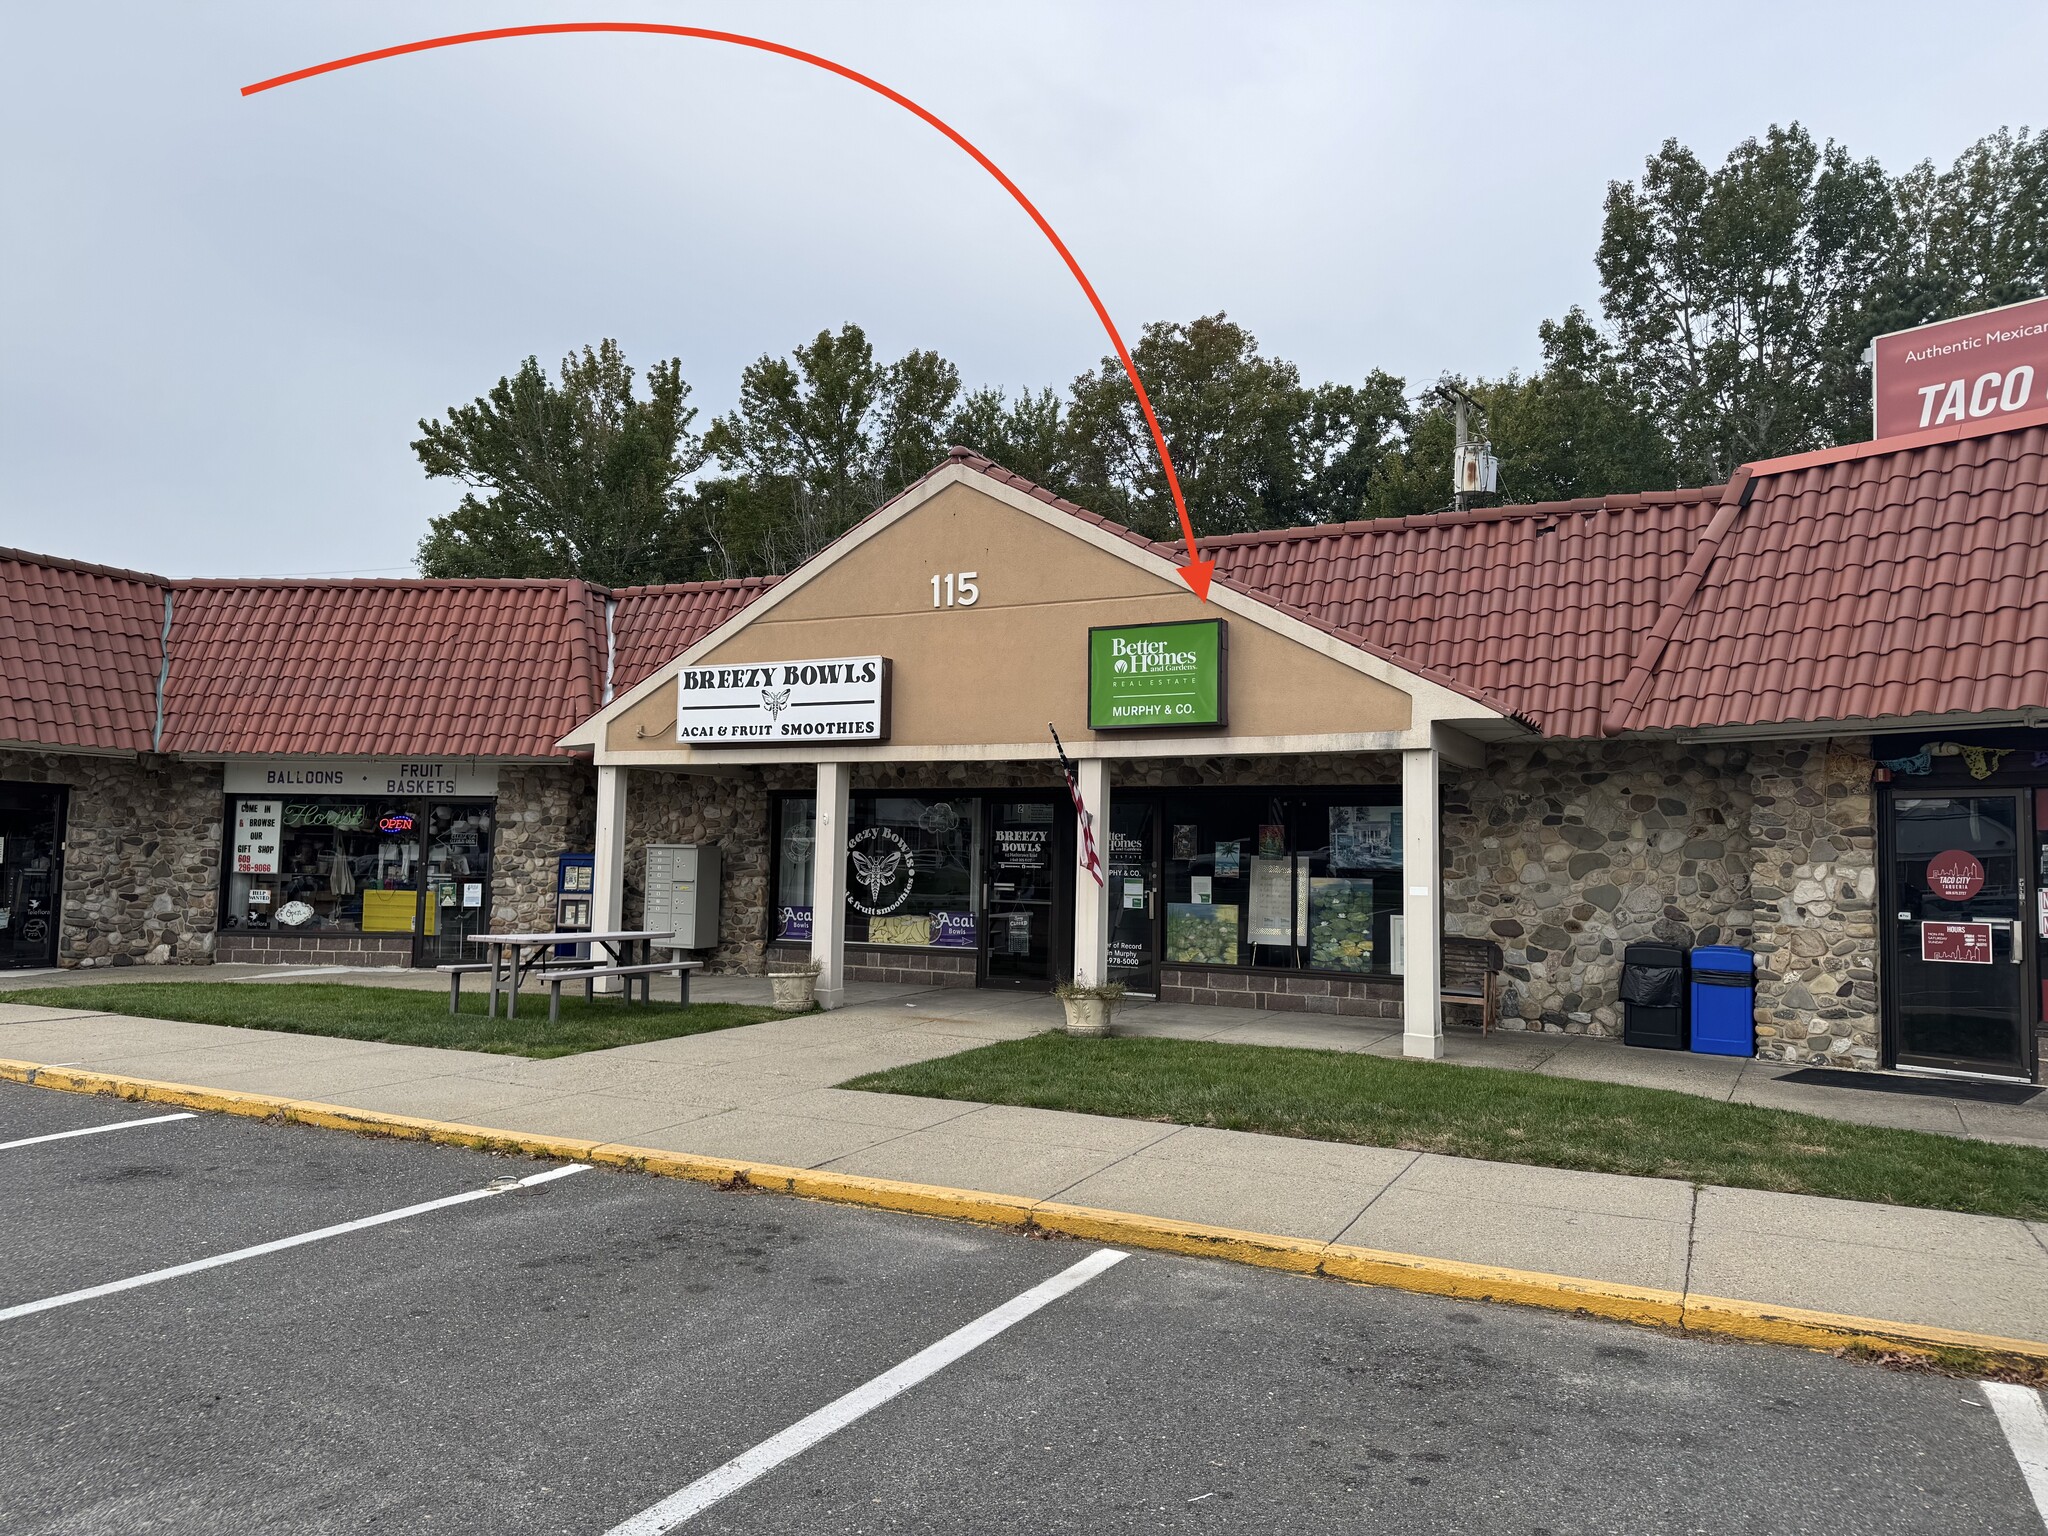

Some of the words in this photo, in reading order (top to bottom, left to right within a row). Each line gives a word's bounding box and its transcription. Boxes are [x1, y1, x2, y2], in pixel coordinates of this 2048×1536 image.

[1905, 337, 1982, 363] Authentic
[1918, 365, 2035, 428] TACO
[930, 572, 979, 608] 115
[1111, 638, 1168, 657] Better
[1129, 651, 1197, 673] Homes
[1165, 663, 1197, 672] Gardens
[683, 667, 777, 689] BREEZY
[783, 662, 876, 686] BOWLS
[1112, 680, 1142, 688] REAL
[1149, 677, 1196, 686] ESTATE
[1112, 704, 1162, 717] MURPHY
[1164, 704, 1172, 715] &
[1175, 703, 1195, 715] CO.
[681, 726, 714, 737] ACAI
[717, 726, 728, 736] &
[731, 725, 773, 737] FRUIT
[781, 721, 875, 736] SMOOTHIES
[400, 764, 443, 778] FRUIT
[267, 771, 344, 785] BALLOONS
[386, 780, 455, 794] BASKETS
[264, 805, 271, 813] IN
[283, 804, 364, 825] Florist
[249, 819, 275, 828] BROWSE
[380, 818, 413, 830] OPEN
[250, 832, 263, 840] OUR
[995, 830, 1048, 842] BREEZY
[1110, 832, 1126, 840] tter
[237, 845, 251, 853] GIFT
[258, 845, 274, 854] SHOP
[1002, 843, 1041, 852] BOWLS
[238, 855, 251, 863] 609
[238, 863, 271, 872] 296-9066
[1940, 876, 1955, 884] TACO
[1956, 876, 1971, 884] CITY
[783, 907, 813, 922] Aca
[936, 912, 974, 928] Acai
[1114, 950, 1137, 959] Murphy
